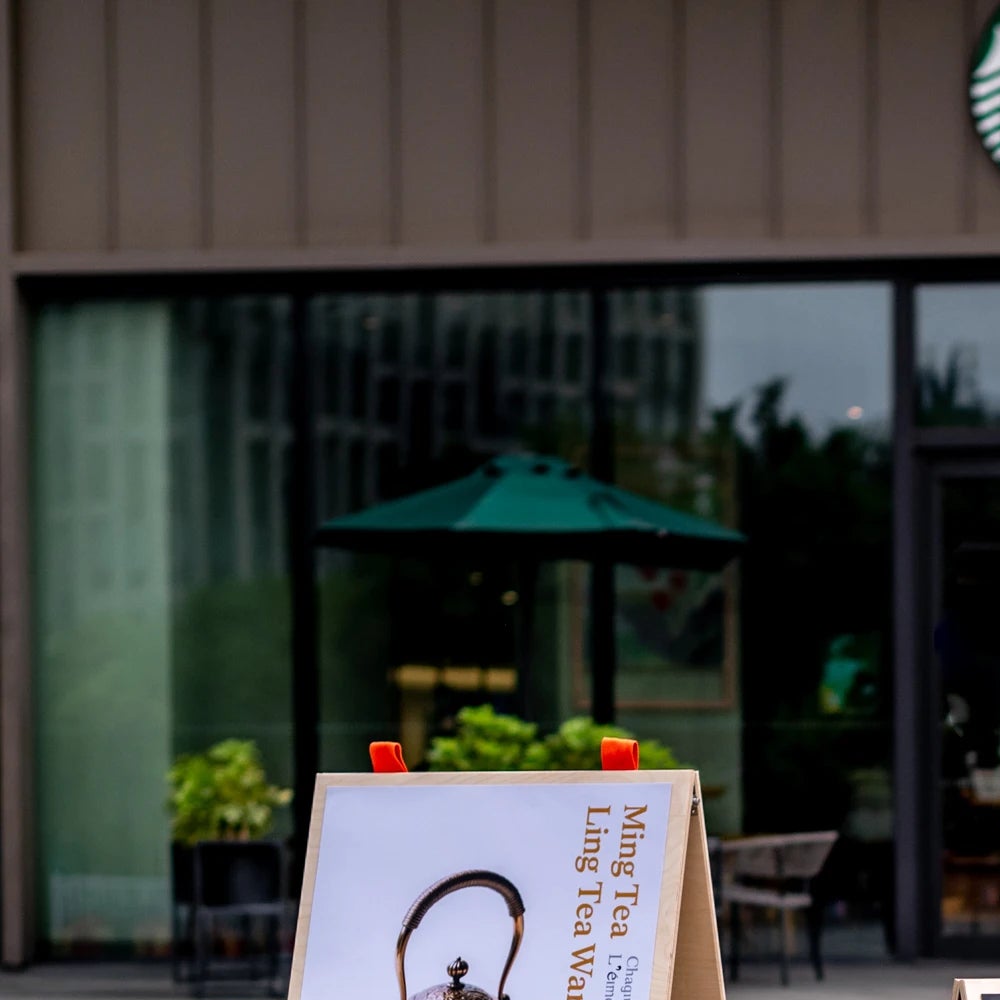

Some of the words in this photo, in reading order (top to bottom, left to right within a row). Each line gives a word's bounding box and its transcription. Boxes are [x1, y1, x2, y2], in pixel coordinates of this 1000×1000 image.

[575, 805, 611, 873] Ling
[611, 804, 648, 878] Ming
[573, 881, 603, 938] Tea
[610, 884, 639, 939] Tea
